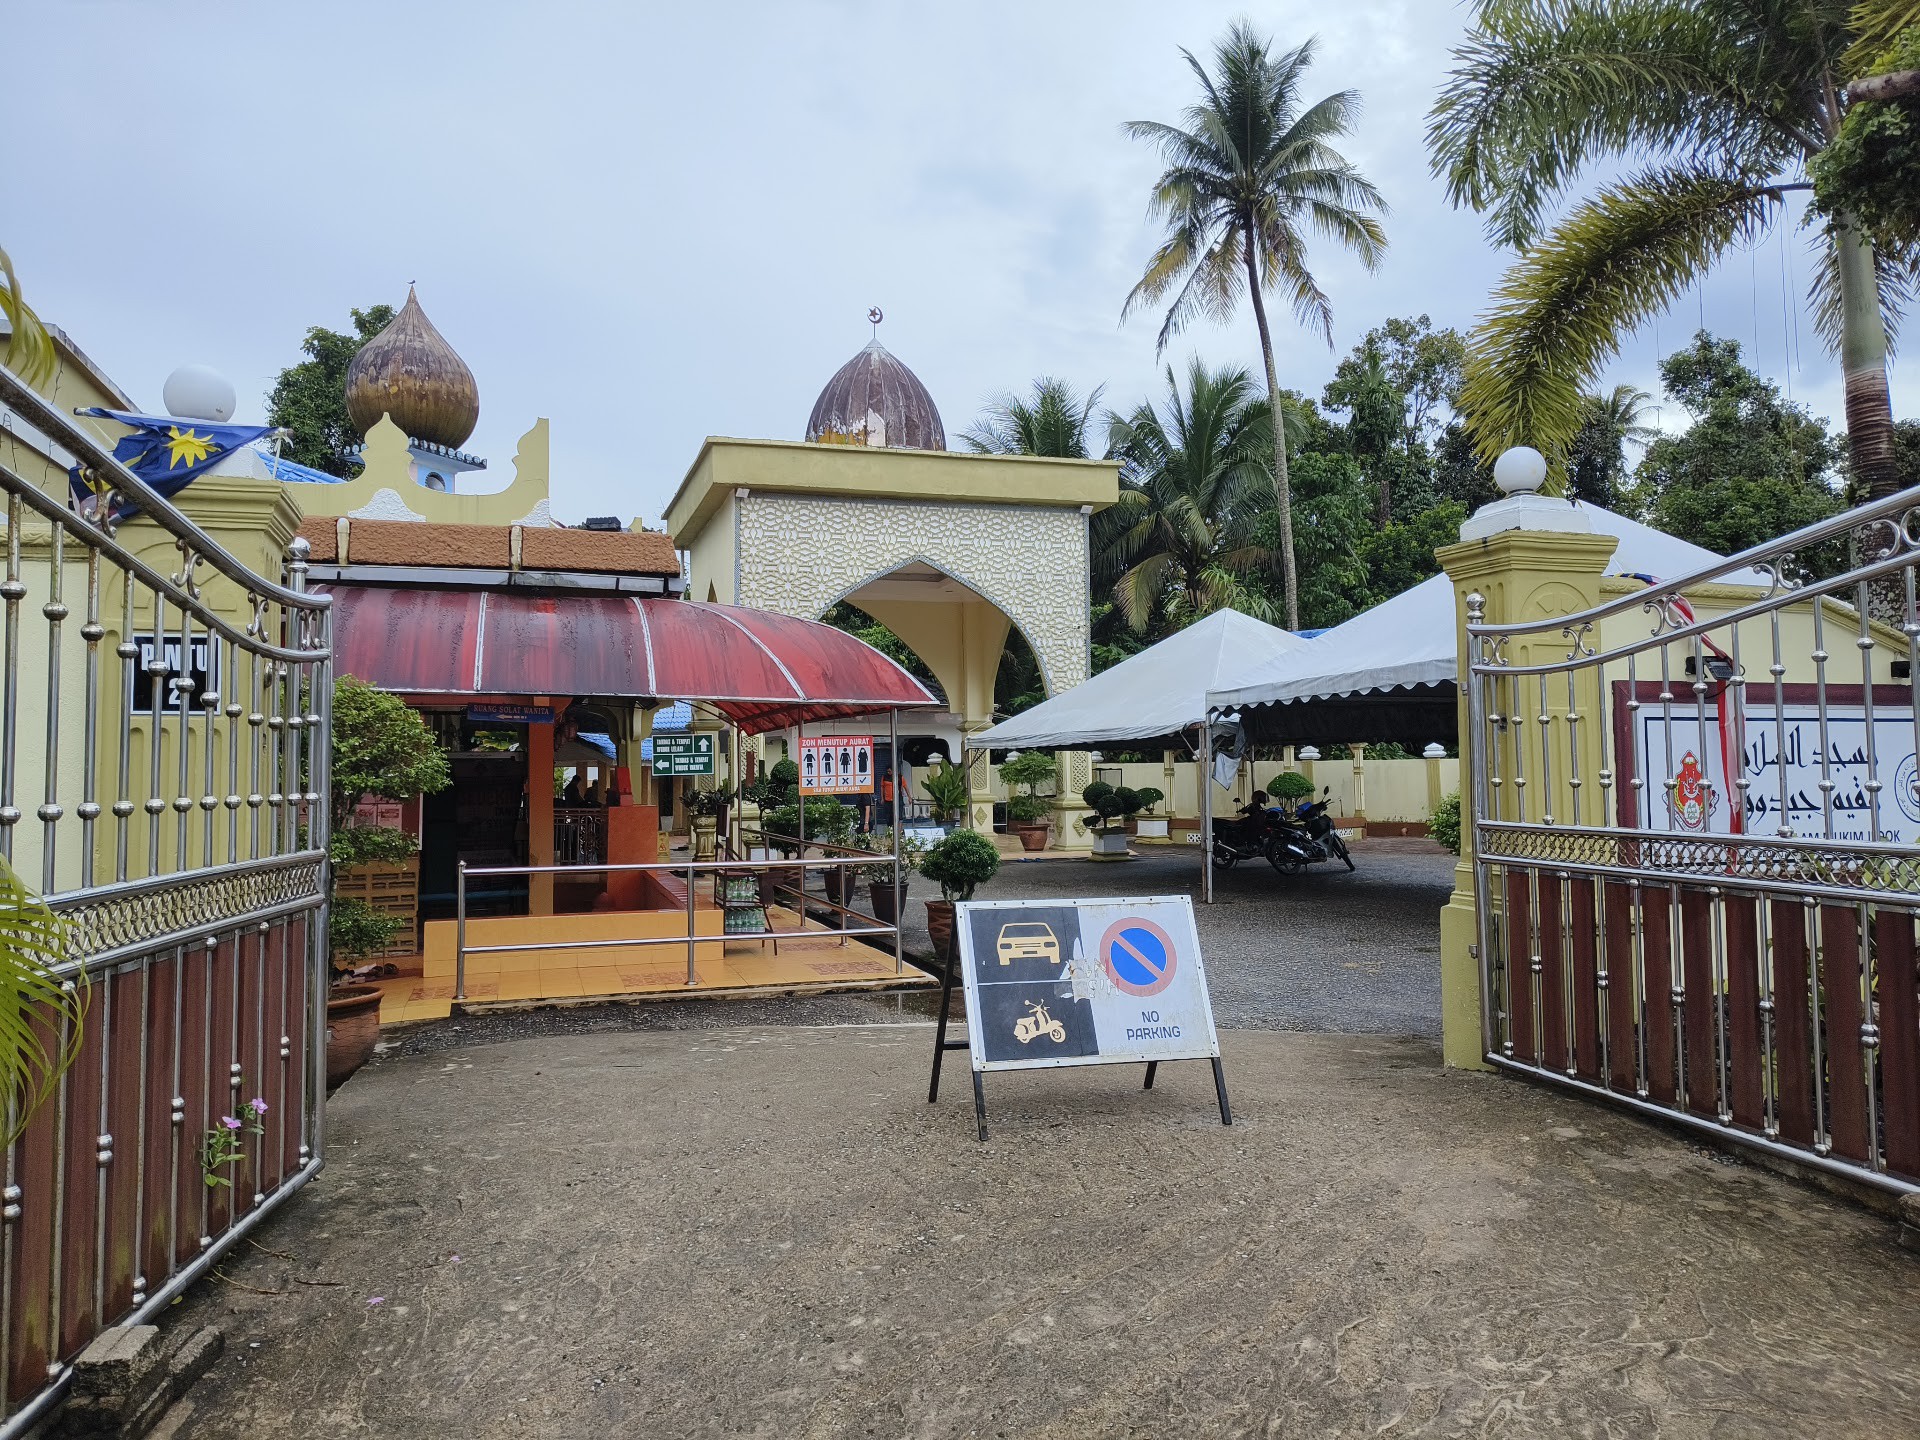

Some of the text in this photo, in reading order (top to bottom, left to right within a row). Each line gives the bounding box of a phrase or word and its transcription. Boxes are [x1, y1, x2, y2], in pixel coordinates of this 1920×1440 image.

[141, 644, 207, 671] PNTU
[168, 678, 184, 704] 2
[474, 704, 549, 715] RUANG SOLAT WANITA
[802, 739, 816, 747] ZON
[817, 738, 848, 746] MENUTUP
[1812, 741, 1878, 773] سجد
[1830, 775, 1880, 819] قيم
[1141, 1010, 1160, 1023] NO
[1126, 1025, 1181, 1041] PARKING
